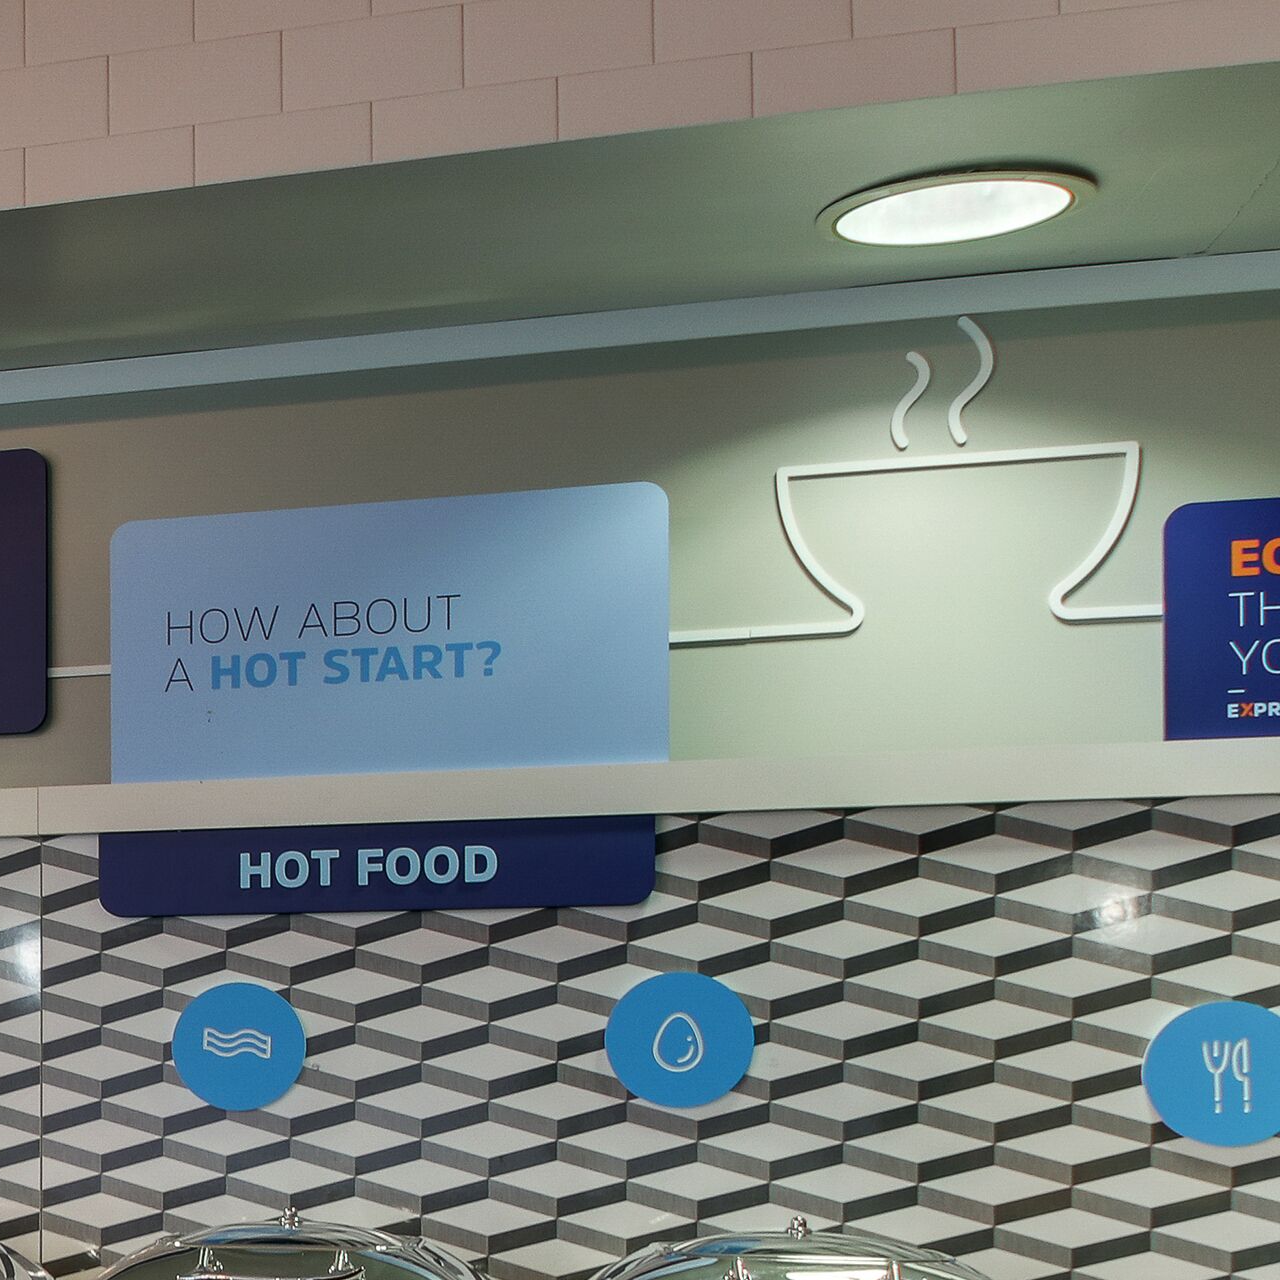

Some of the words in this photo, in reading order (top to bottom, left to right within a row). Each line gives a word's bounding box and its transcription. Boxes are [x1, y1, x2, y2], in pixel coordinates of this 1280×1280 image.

[165, 605, 279, 646] HOW
[297, 593, 461, 640] ABOUT
[164, 656, 194, 694] A
[210, 651, 306, 690] HOT
[322, 640, 502, 685] START?
[239, 849, 339, 889] HOT
[357, 845, 498, 886] FOOD
